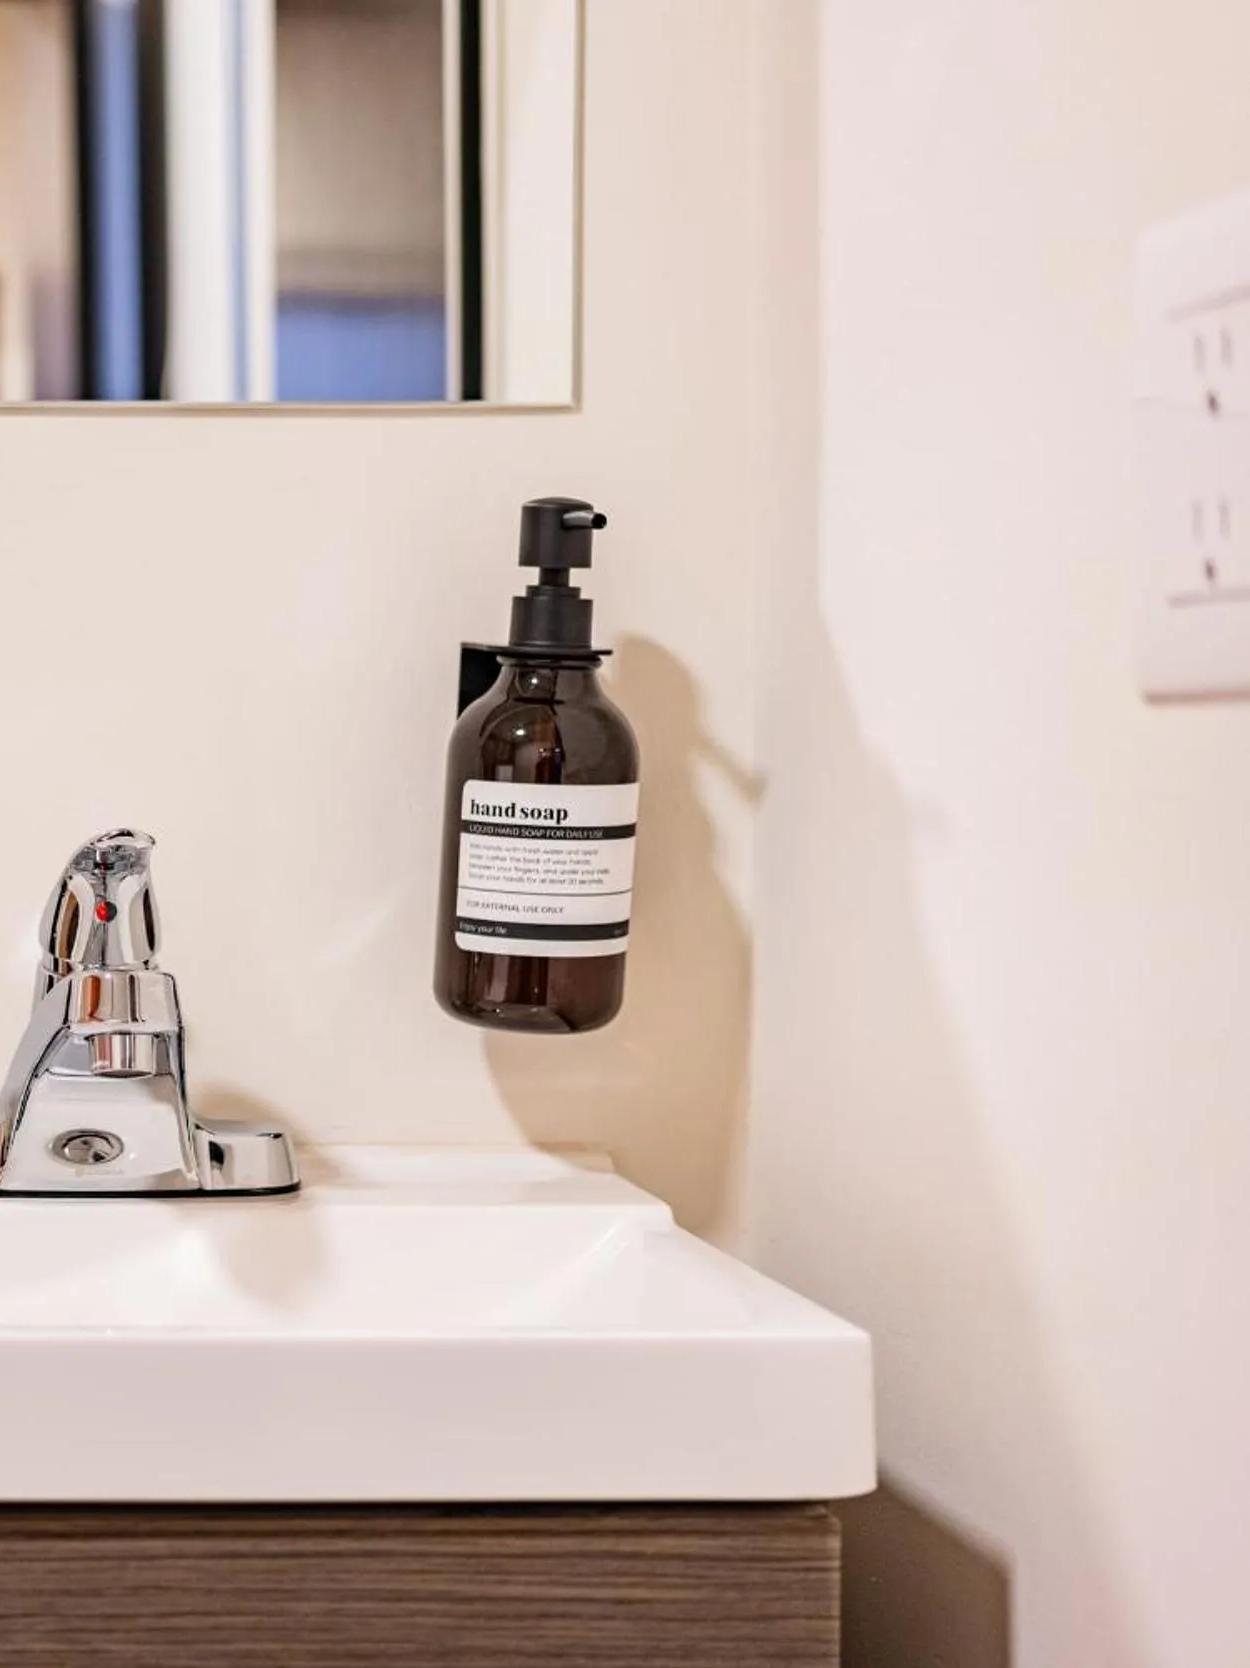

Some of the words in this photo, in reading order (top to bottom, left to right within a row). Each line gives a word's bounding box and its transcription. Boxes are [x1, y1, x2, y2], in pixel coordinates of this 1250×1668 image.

[470, 799, 516, 818] hand
[520, 806, 568, 825] soap
[495, 826, 519, 836] HAND
[521, 827, 546, 837] SOAP
[546, 829, 565, 838] FOR
